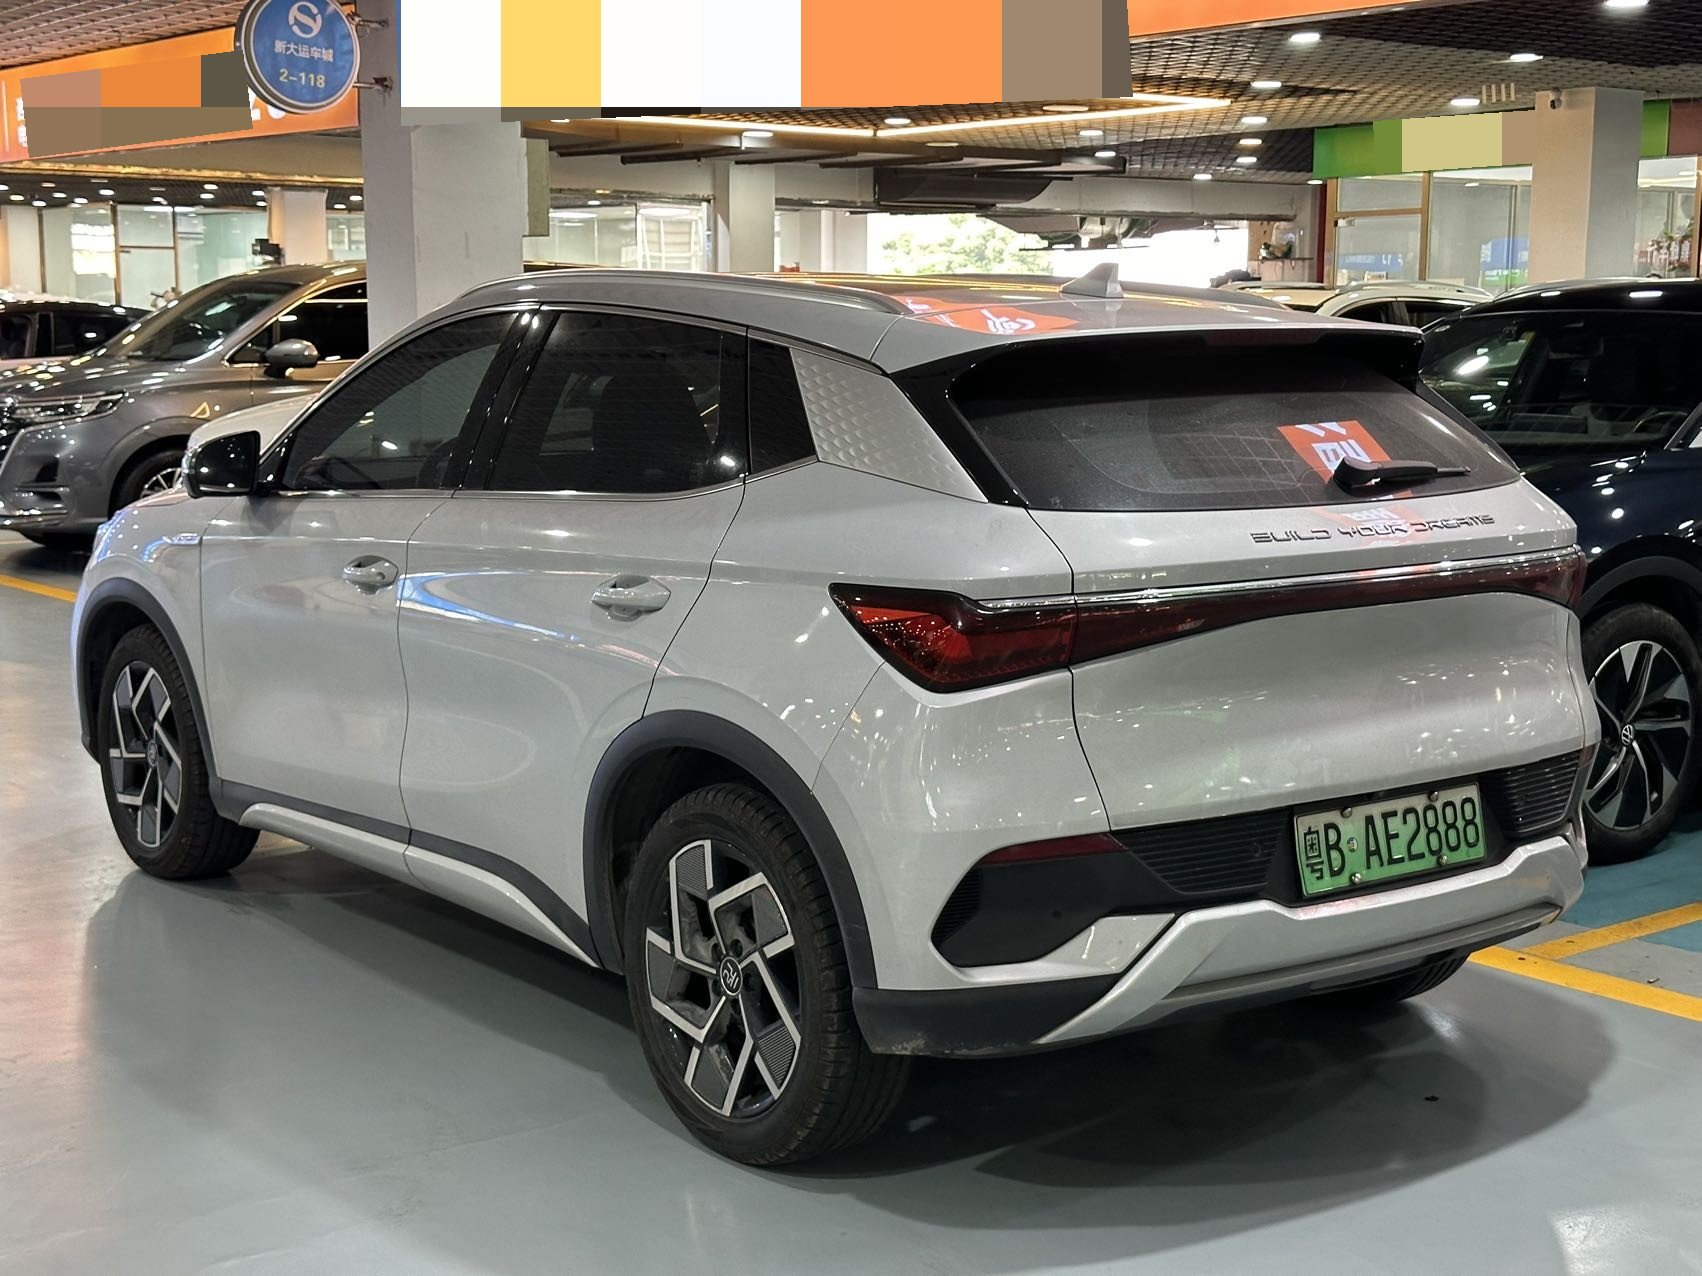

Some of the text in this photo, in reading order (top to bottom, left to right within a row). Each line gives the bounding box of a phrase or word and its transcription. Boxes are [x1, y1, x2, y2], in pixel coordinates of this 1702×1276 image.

[274, 40, 334, 62] 新大运车城
[279, 68, 326, 88] 2-118
[1250, 515, 1495, 543] BUILD YOUR DREAMS
